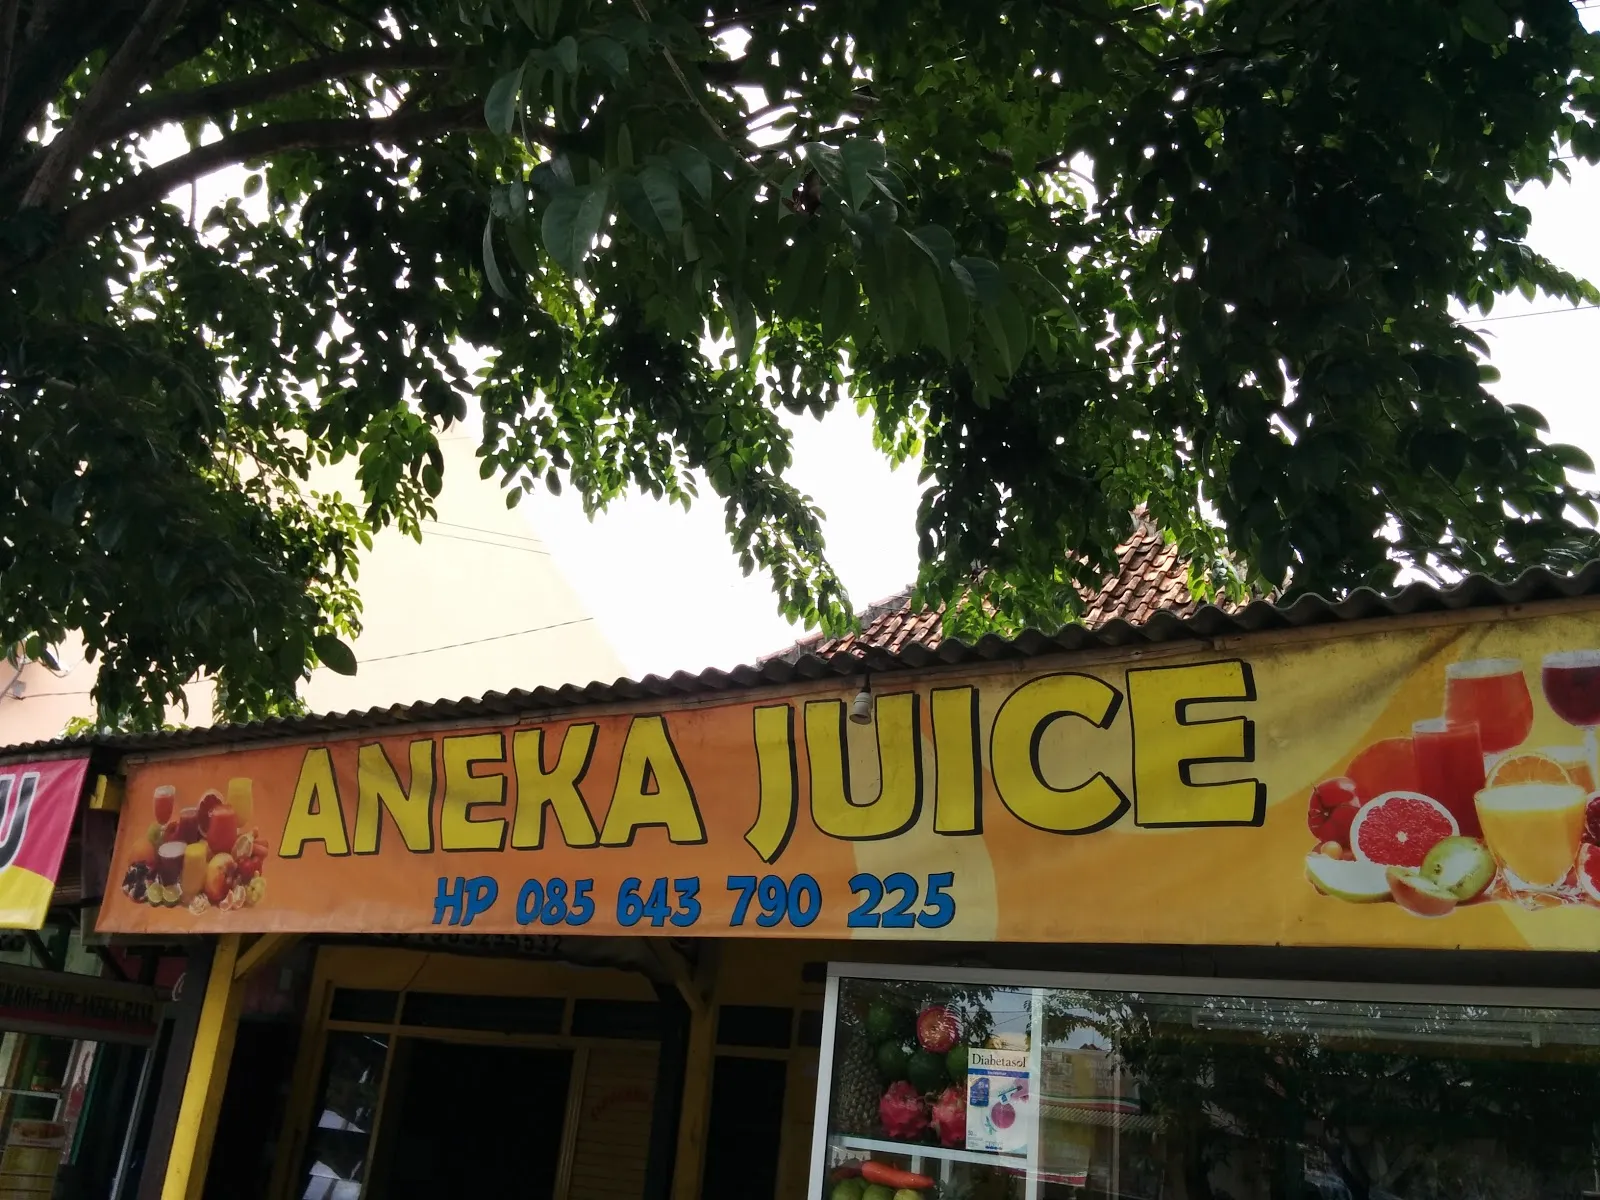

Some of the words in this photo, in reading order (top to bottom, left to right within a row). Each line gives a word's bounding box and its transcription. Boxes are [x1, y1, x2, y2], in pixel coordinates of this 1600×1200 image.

[278, 714, 708, 858] ANEKA
[743, 658, 1267, 865] JUICE
[431, 875, 499, 926] HP
[516, 877, 595, 926] 085
[616, 875, 701, 928] 643
[725, 873, 822, 927] 790
[847, 872, 955, 929] 225
[972, 1053, 1026, 1068] Diabetasol
